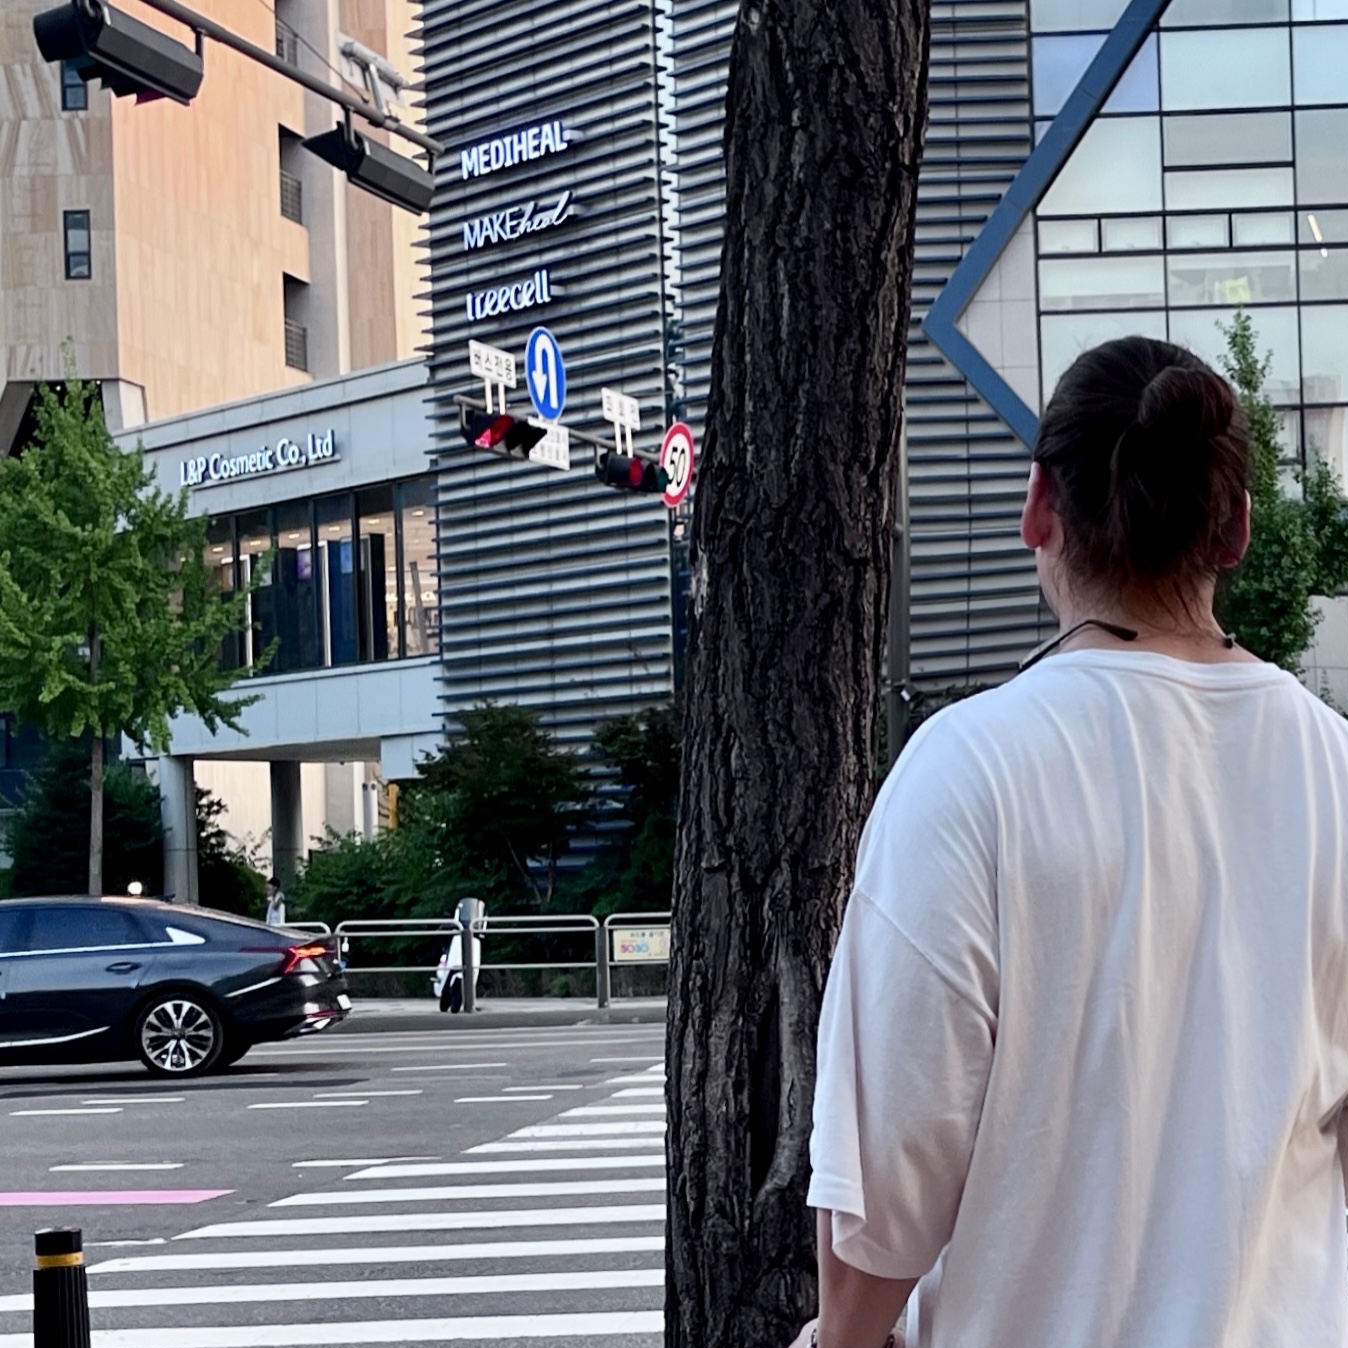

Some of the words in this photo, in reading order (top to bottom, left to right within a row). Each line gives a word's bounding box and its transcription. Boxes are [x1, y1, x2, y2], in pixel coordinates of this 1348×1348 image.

[460, 120, 568, 180] MEDIHEAL
[180, 456, 207, 486] L&P
[208, 446, 273, 480] Cosmetic
[307, 428, 334, 460] Ltd
[669, 446, 686, 488] 50
